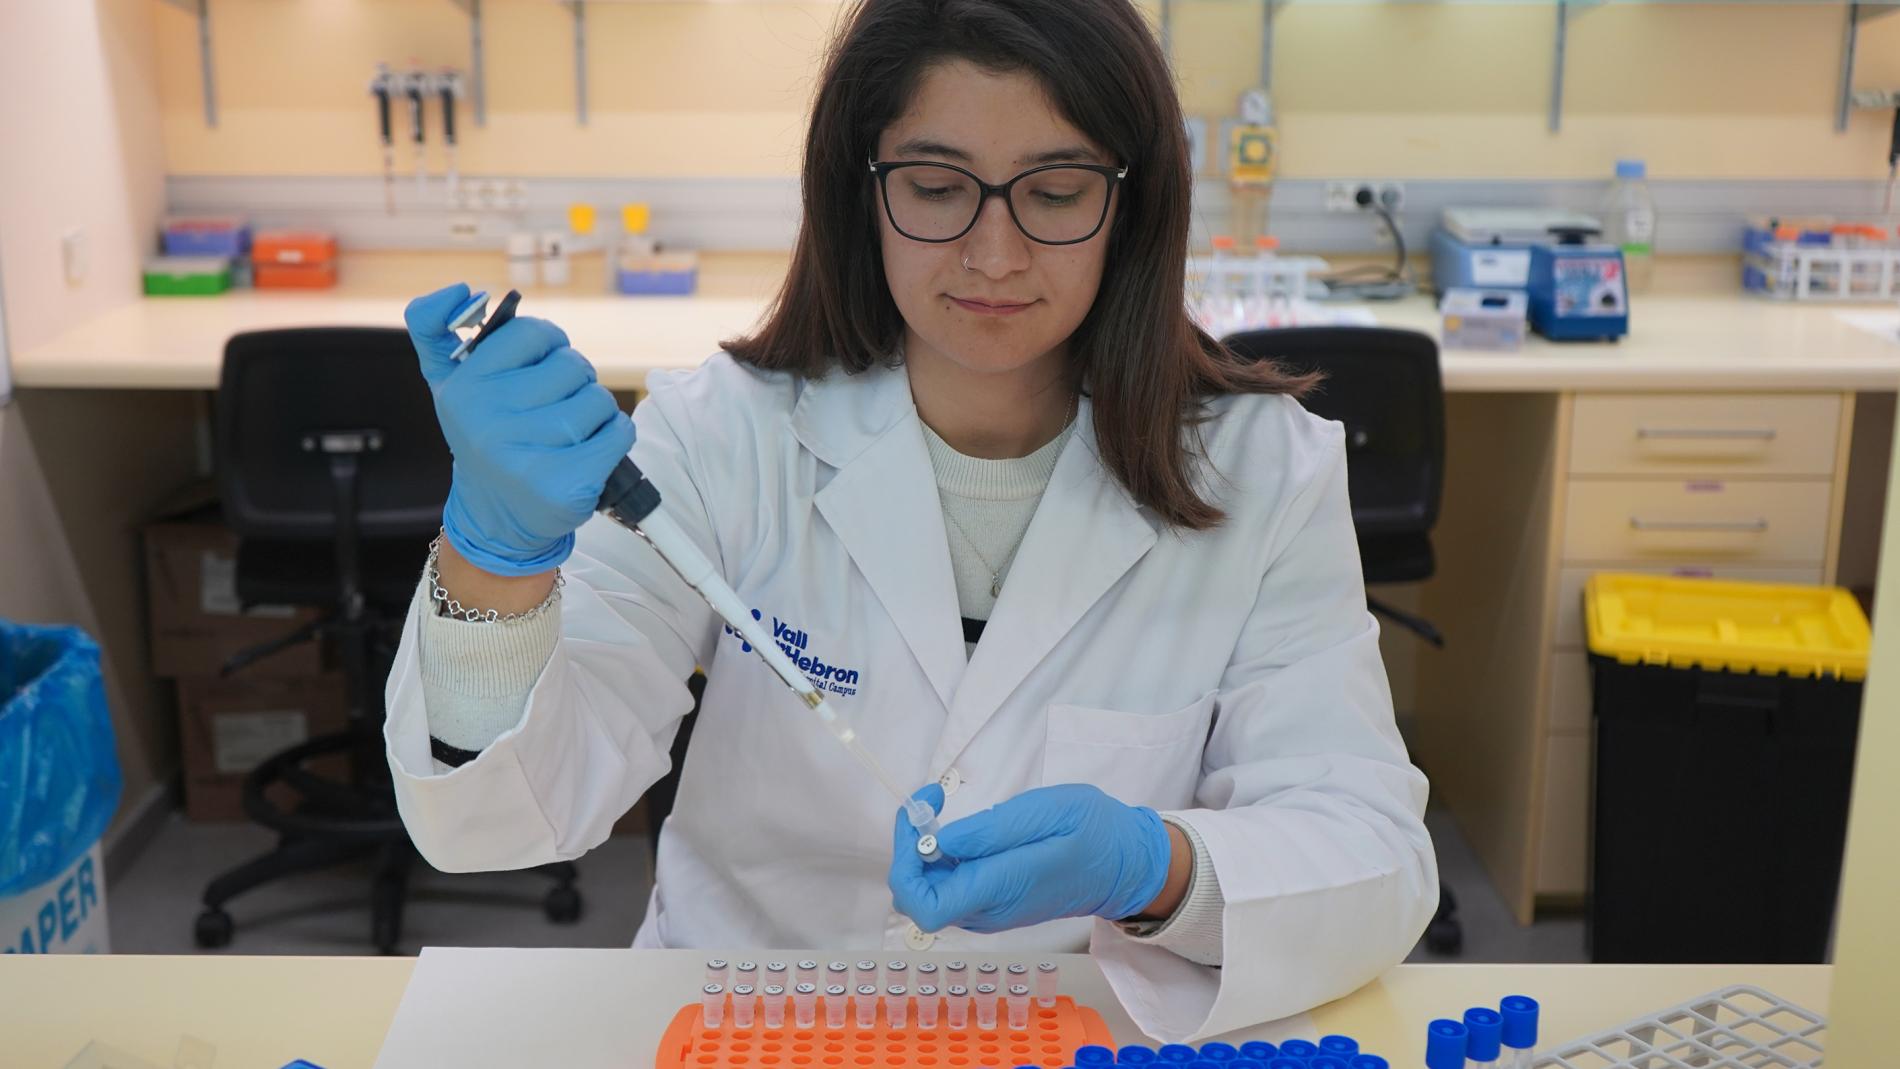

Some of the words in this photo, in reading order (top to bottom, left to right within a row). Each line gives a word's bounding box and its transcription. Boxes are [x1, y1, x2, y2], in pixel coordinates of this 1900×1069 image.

[773, 617, 808, 649] Vall
[775, 640, 859, 684] 'Hebron
[828, 682, 857, 697] Campus
